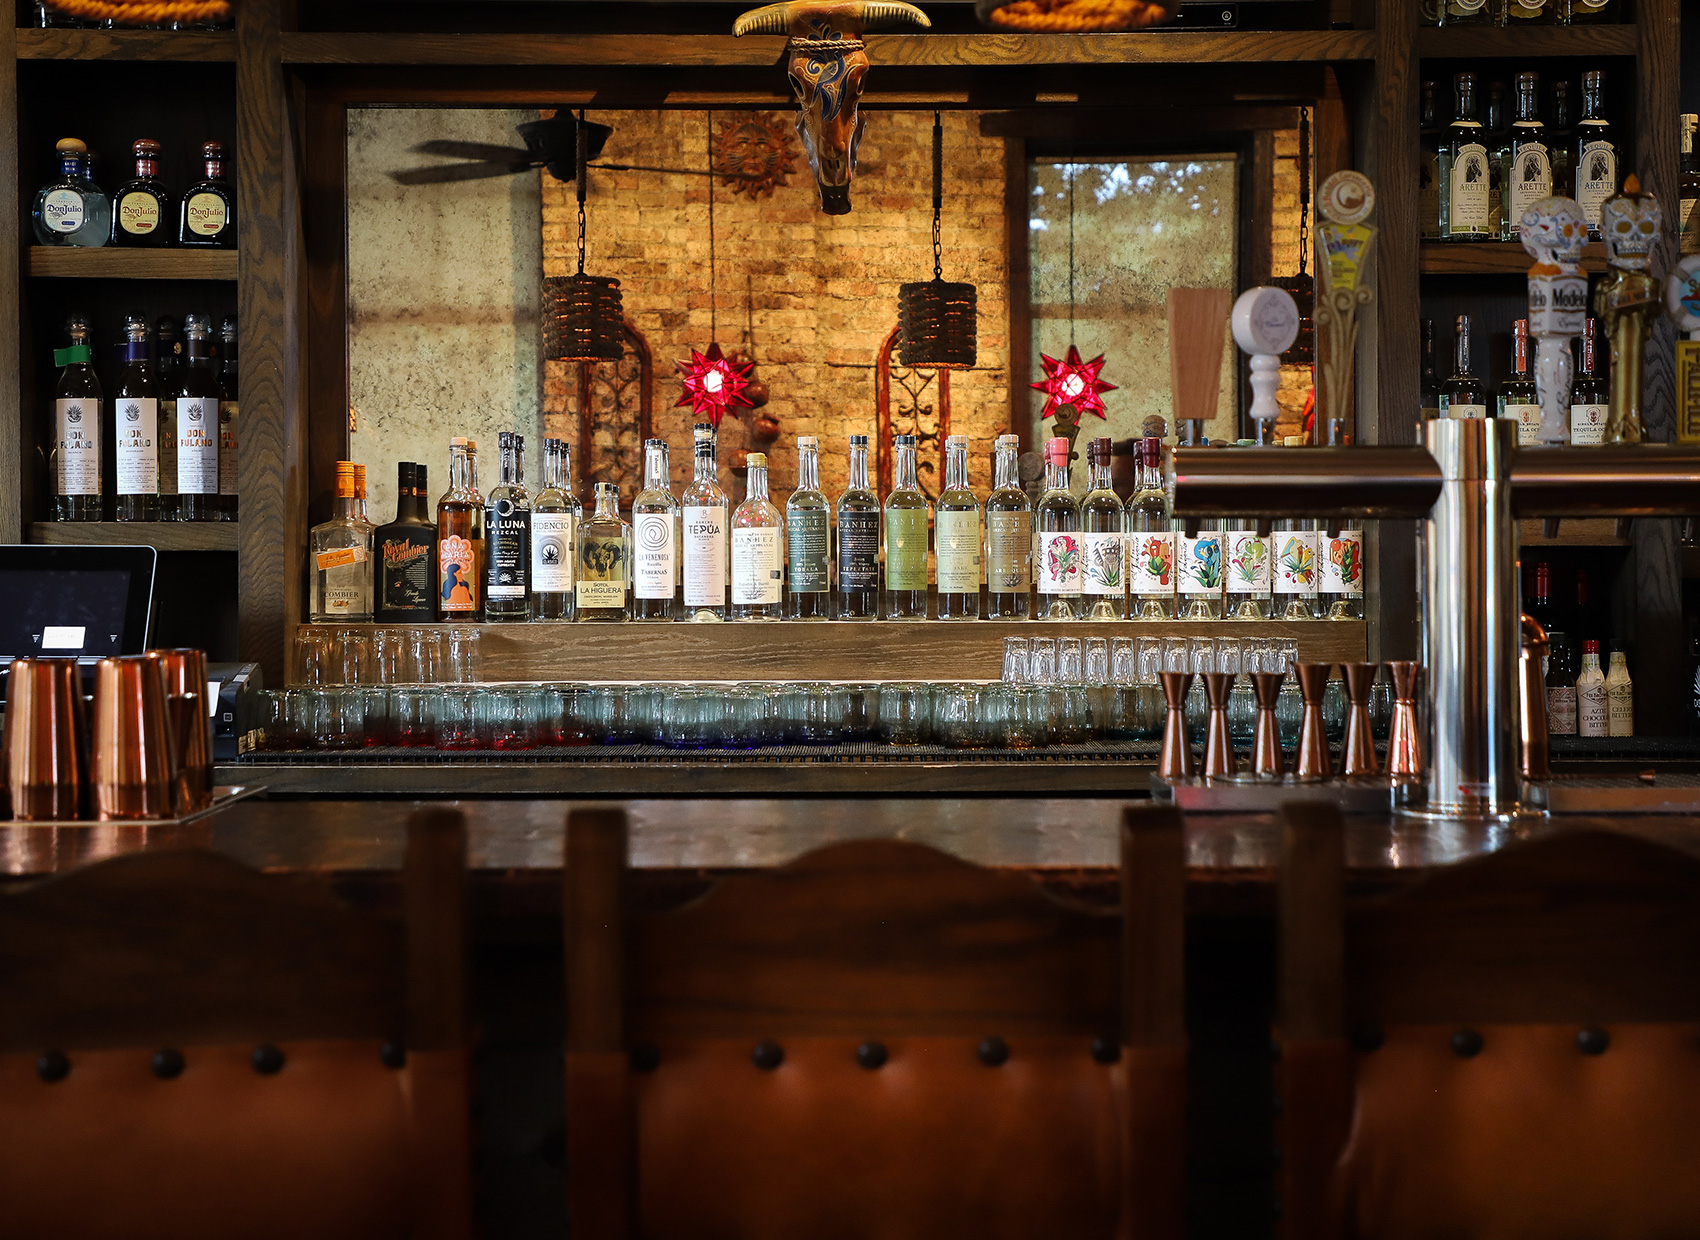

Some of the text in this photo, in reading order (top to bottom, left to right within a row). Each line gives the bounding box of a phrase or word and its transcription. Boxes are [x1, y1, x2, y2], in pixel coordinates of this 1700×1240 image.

[1460, 184, 1487, 192] ARETTE
[1518, 183, 1547, 191] ARETTE
[1585, 182, 1614, 190] ARETTE
[1552, 288, 1587, 307] Modelo
[66, 431, 85, 440] DON
[125, 430, 143, 439] DON
[187, 430, 205, 438] DON
[60, 441, 93, 449] FULANO
[119, 440, 151, 448] FULANO
[181, 439, 213, 447] FULANO
[487, 520, 526, 529] LA LUNA
[533, 522, 569, 530] FIDENCIO
[688, 523, 721, 535] TEPÚA
[382, 538, 410, 558] Royal
[392, 545, 430, 563] Combier
[645, 553, 669, 561] VENENOSA
[591, 586, 622, 594] HIGUERA
